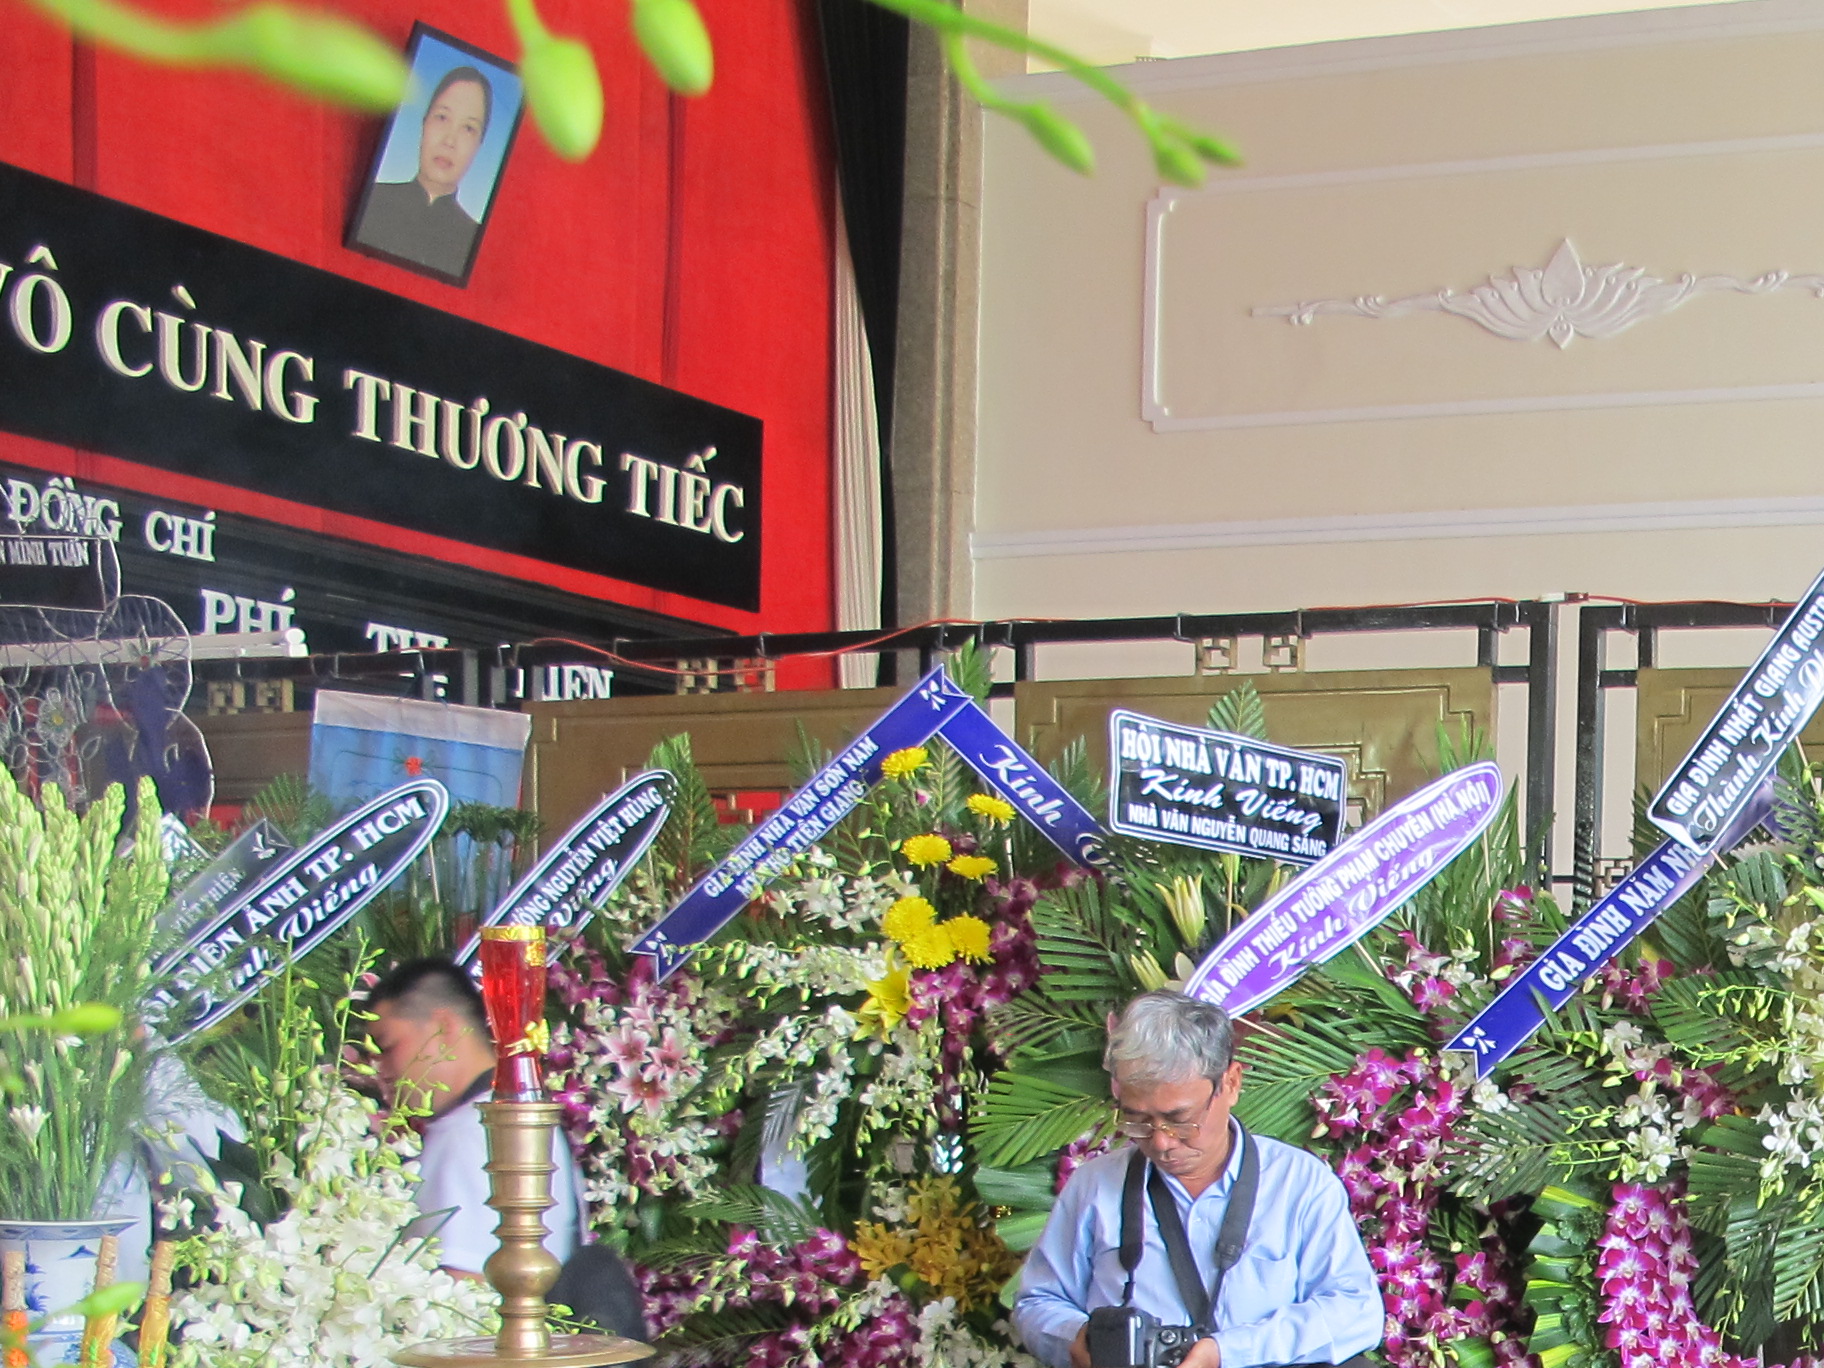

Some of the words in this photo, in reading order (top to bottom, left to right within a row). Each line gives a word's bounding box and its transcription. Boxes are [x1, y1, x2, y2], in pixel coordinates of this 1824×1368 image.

[96, 284, 319, 424] CÙNG
[343, 368, 608, 504] THƯƠNG
[620, 446, 746, 543] TIẾC
[7, 476, 124, 542] ĐỒNG
[145, 510, 217, 562] CHÍ
[843, 735, 880, 771] NAM
[1121, 724, 1161, 768] HỘI
[1164, 736, 1212, 774] NHÀ
[1215, 743, 1262, 784] VĂN
[1265, 760, 1297, 791] TP.
[1299, 765, 1340, 800] HCM
[1666, 781, 1700, 816] GIA
[1687, 738, 1732, 787] ĐÌNH
[1753, 643, 1802, 698] GIANG
[1693, 753, 1762, 832] Thành
[1751, 690, 1806, 757] Kính
[588, 818, 627, 851] VIỆT
[618, 786, 664, 827] HÙNG
[820, 779, 867, 821] GIANG
[978, 743, 1064, 828] Kính
[1140, 768, 1225, 809] Kính
[1235, 788, 1323, 833] Viếng
[243, 877, 309, 934] ẢNH
[304, 845, 354, 883] TP.
[352, 796, 428, 851] HCM
[1128, 802, 1158, 827] NHÀ
[1161, 808, 1189, 833] VĂN
[1191, 815, 1247, 843] NGUYỄN
[1250, 829, 1289, 850] QUANG
[1292, 832, 1327, 856] SÁNG
[279, 862, 382, 943] Viếng
[1219, 945, 1261, 988] ĐÌNH
[1251, 911, 1299, 956] THIẾU
[1336, 848, 1380, 891] PHẠM
[1374, 811, 1435, 862] CHUYÊN
[1571, 904, 1632, 961] ĐÌNH
[1618, 864, 1676, 917] NĂM
